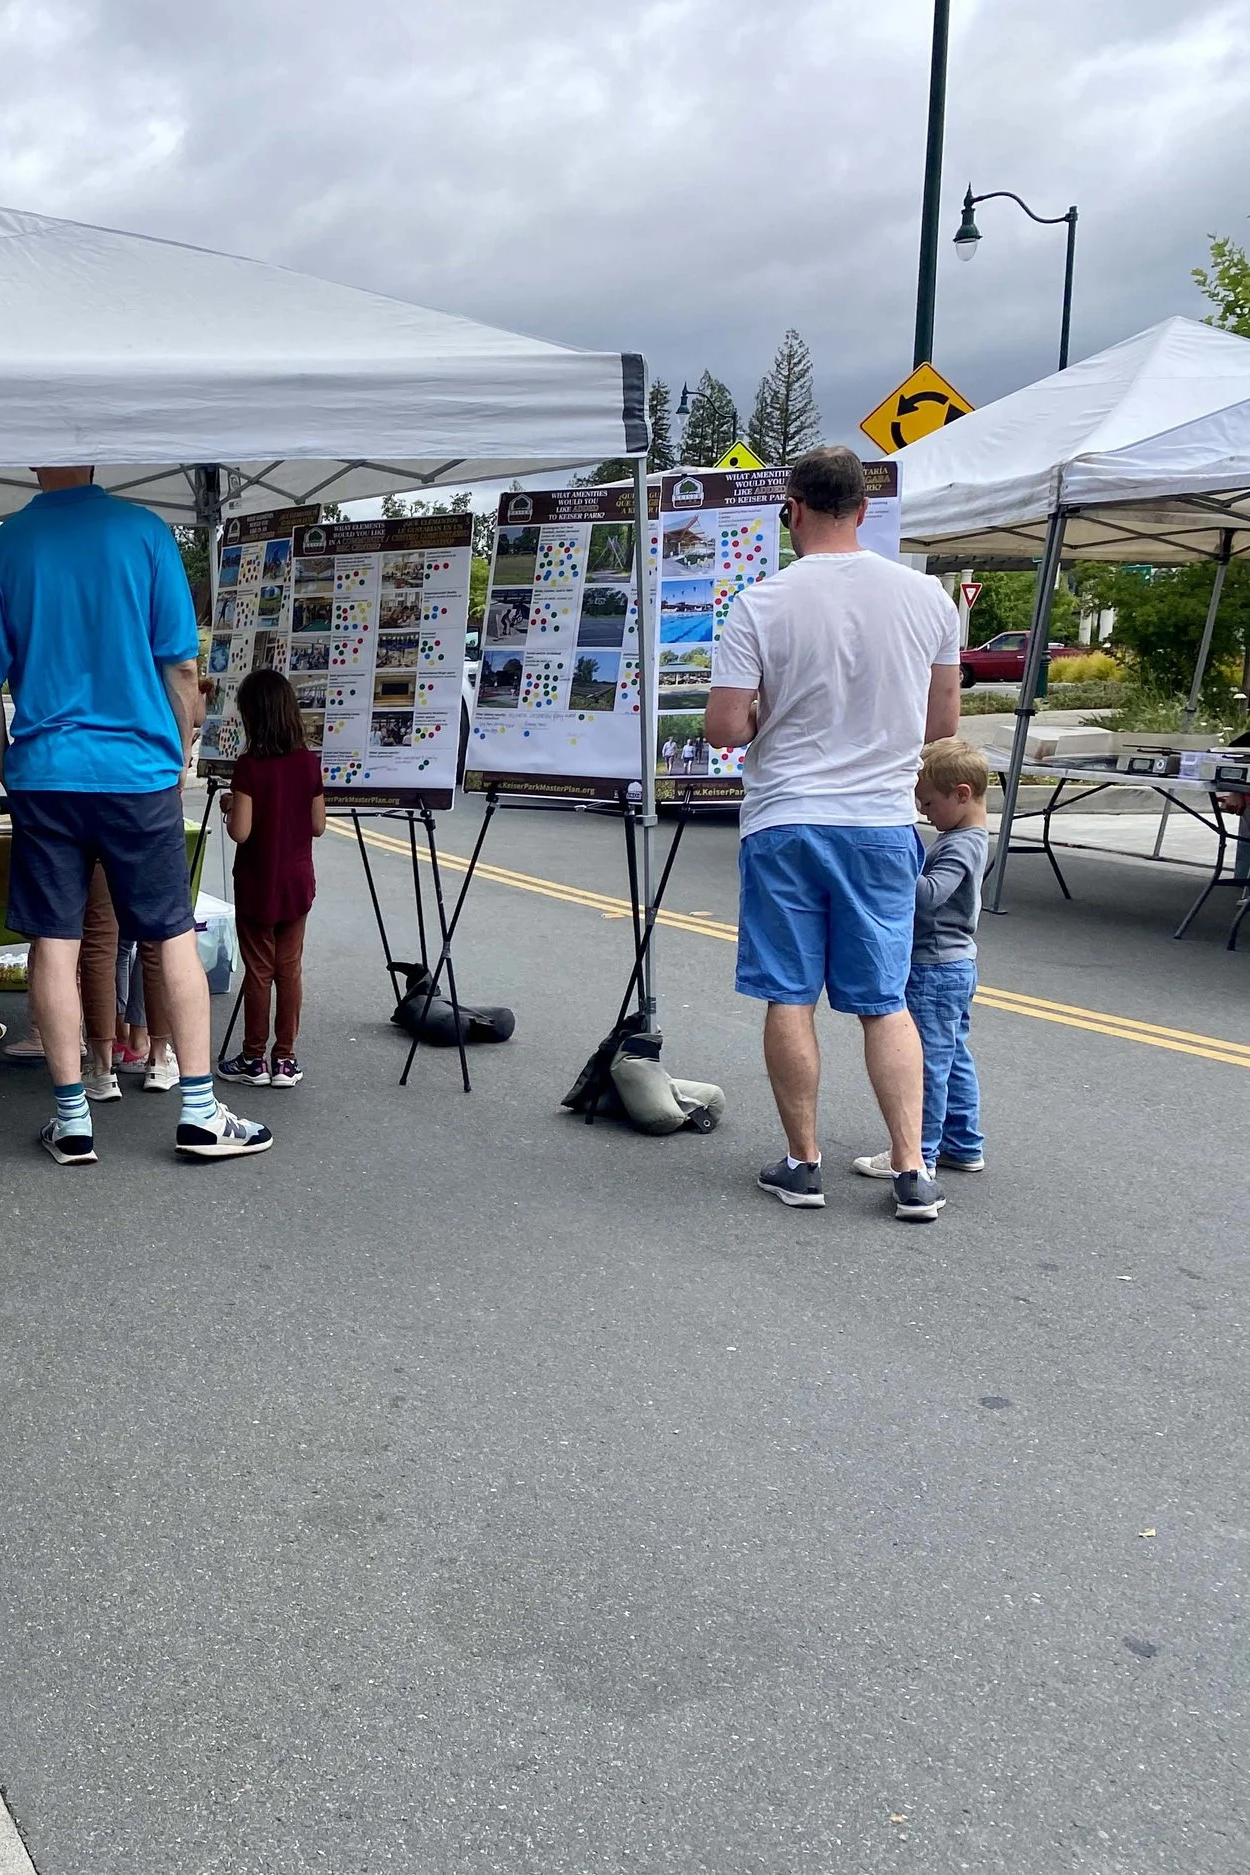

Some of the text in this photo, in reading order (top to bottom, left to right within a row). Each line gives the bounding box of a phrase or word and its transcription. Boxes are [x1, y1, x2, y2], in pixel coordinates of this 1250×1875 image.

[726, 470, 791, 481] WHAT AMENITIE
[571, 490, 608, 498] AMENITIES
